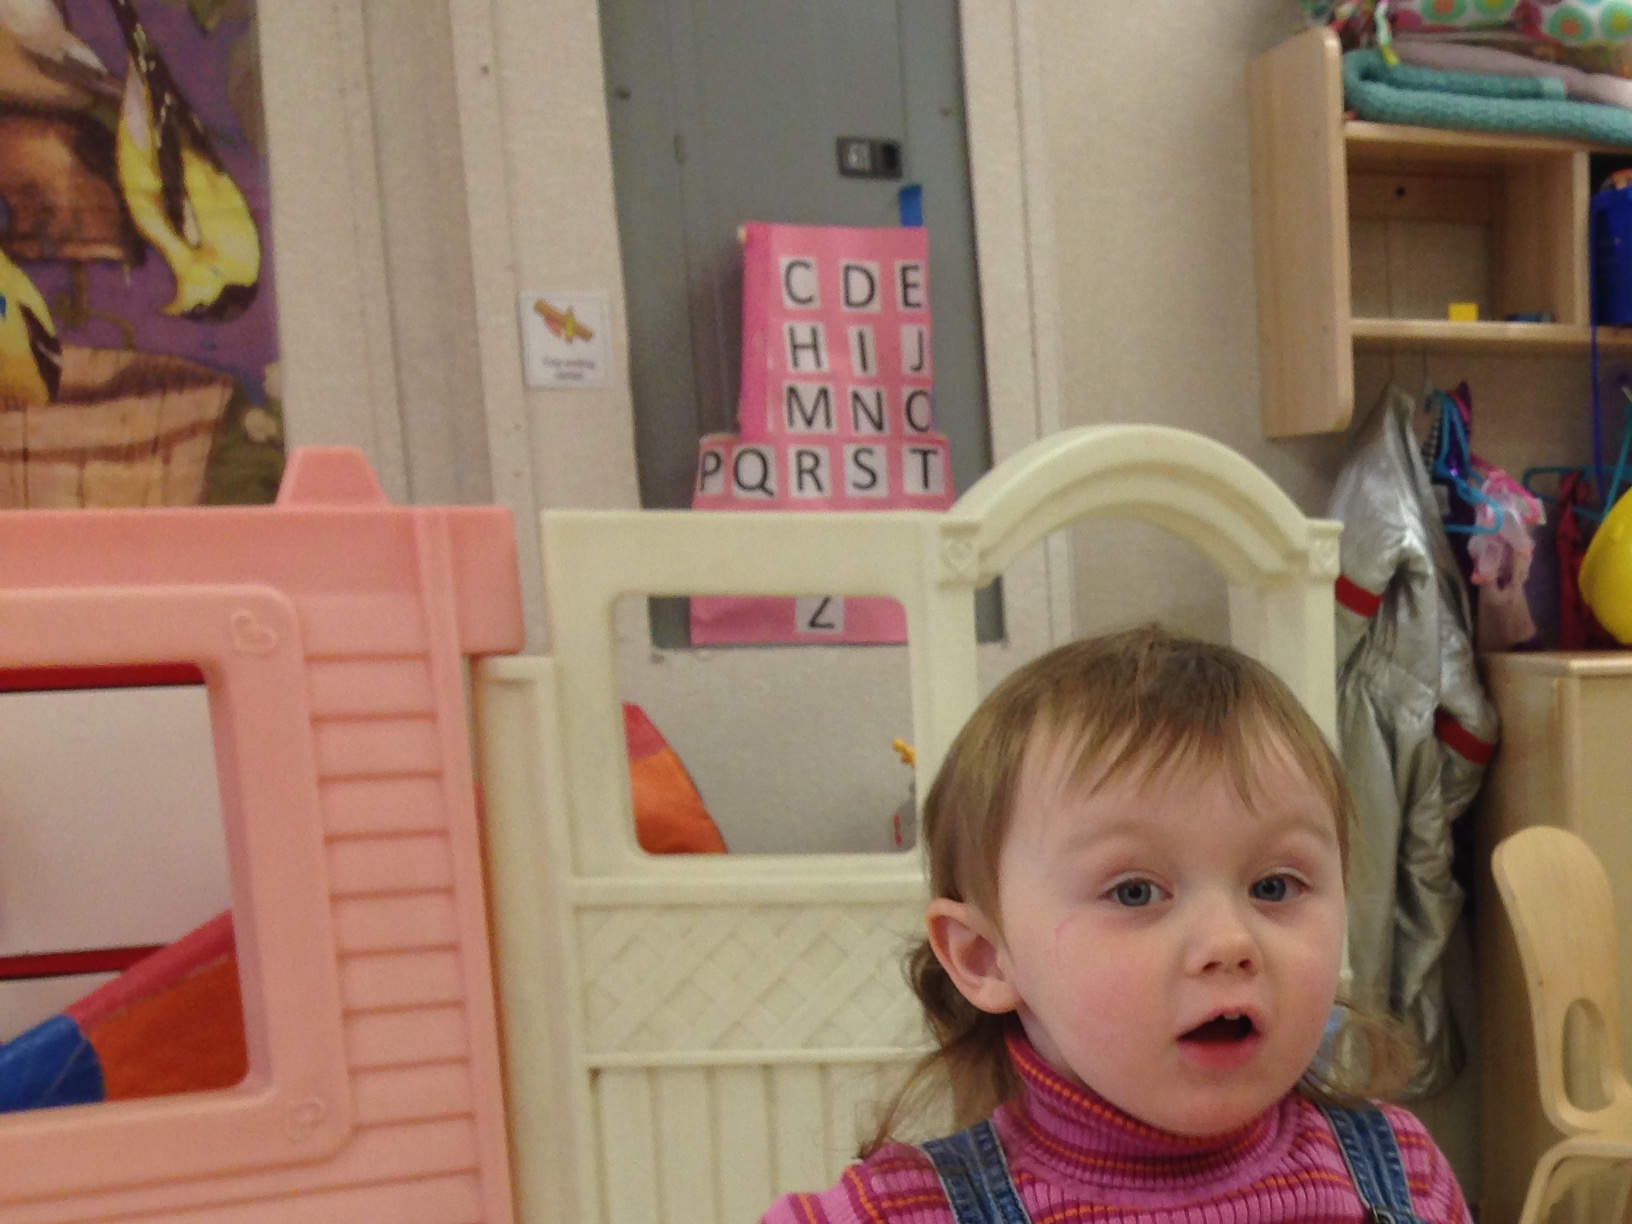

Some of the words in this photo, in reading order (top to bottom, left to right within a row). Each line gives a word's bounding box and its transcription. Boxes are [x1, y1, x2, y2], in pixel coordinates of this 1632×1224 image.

[784, 261, 814, 304] C
[843, 265, 876, 308] D
[902, 265, 923, 308] E
[787, 326, 823, 368] H
[908, 329, 924, 371] J
[786, 386, 832, 430] M
[851, 392, 884, 432] N
[701, 453, 723, 492] P
[733, 448, 775, 496] Q
[797, 452, 828, 492] R
[852, 448, 879, 489] S
[910, 449, 939, 490] T
